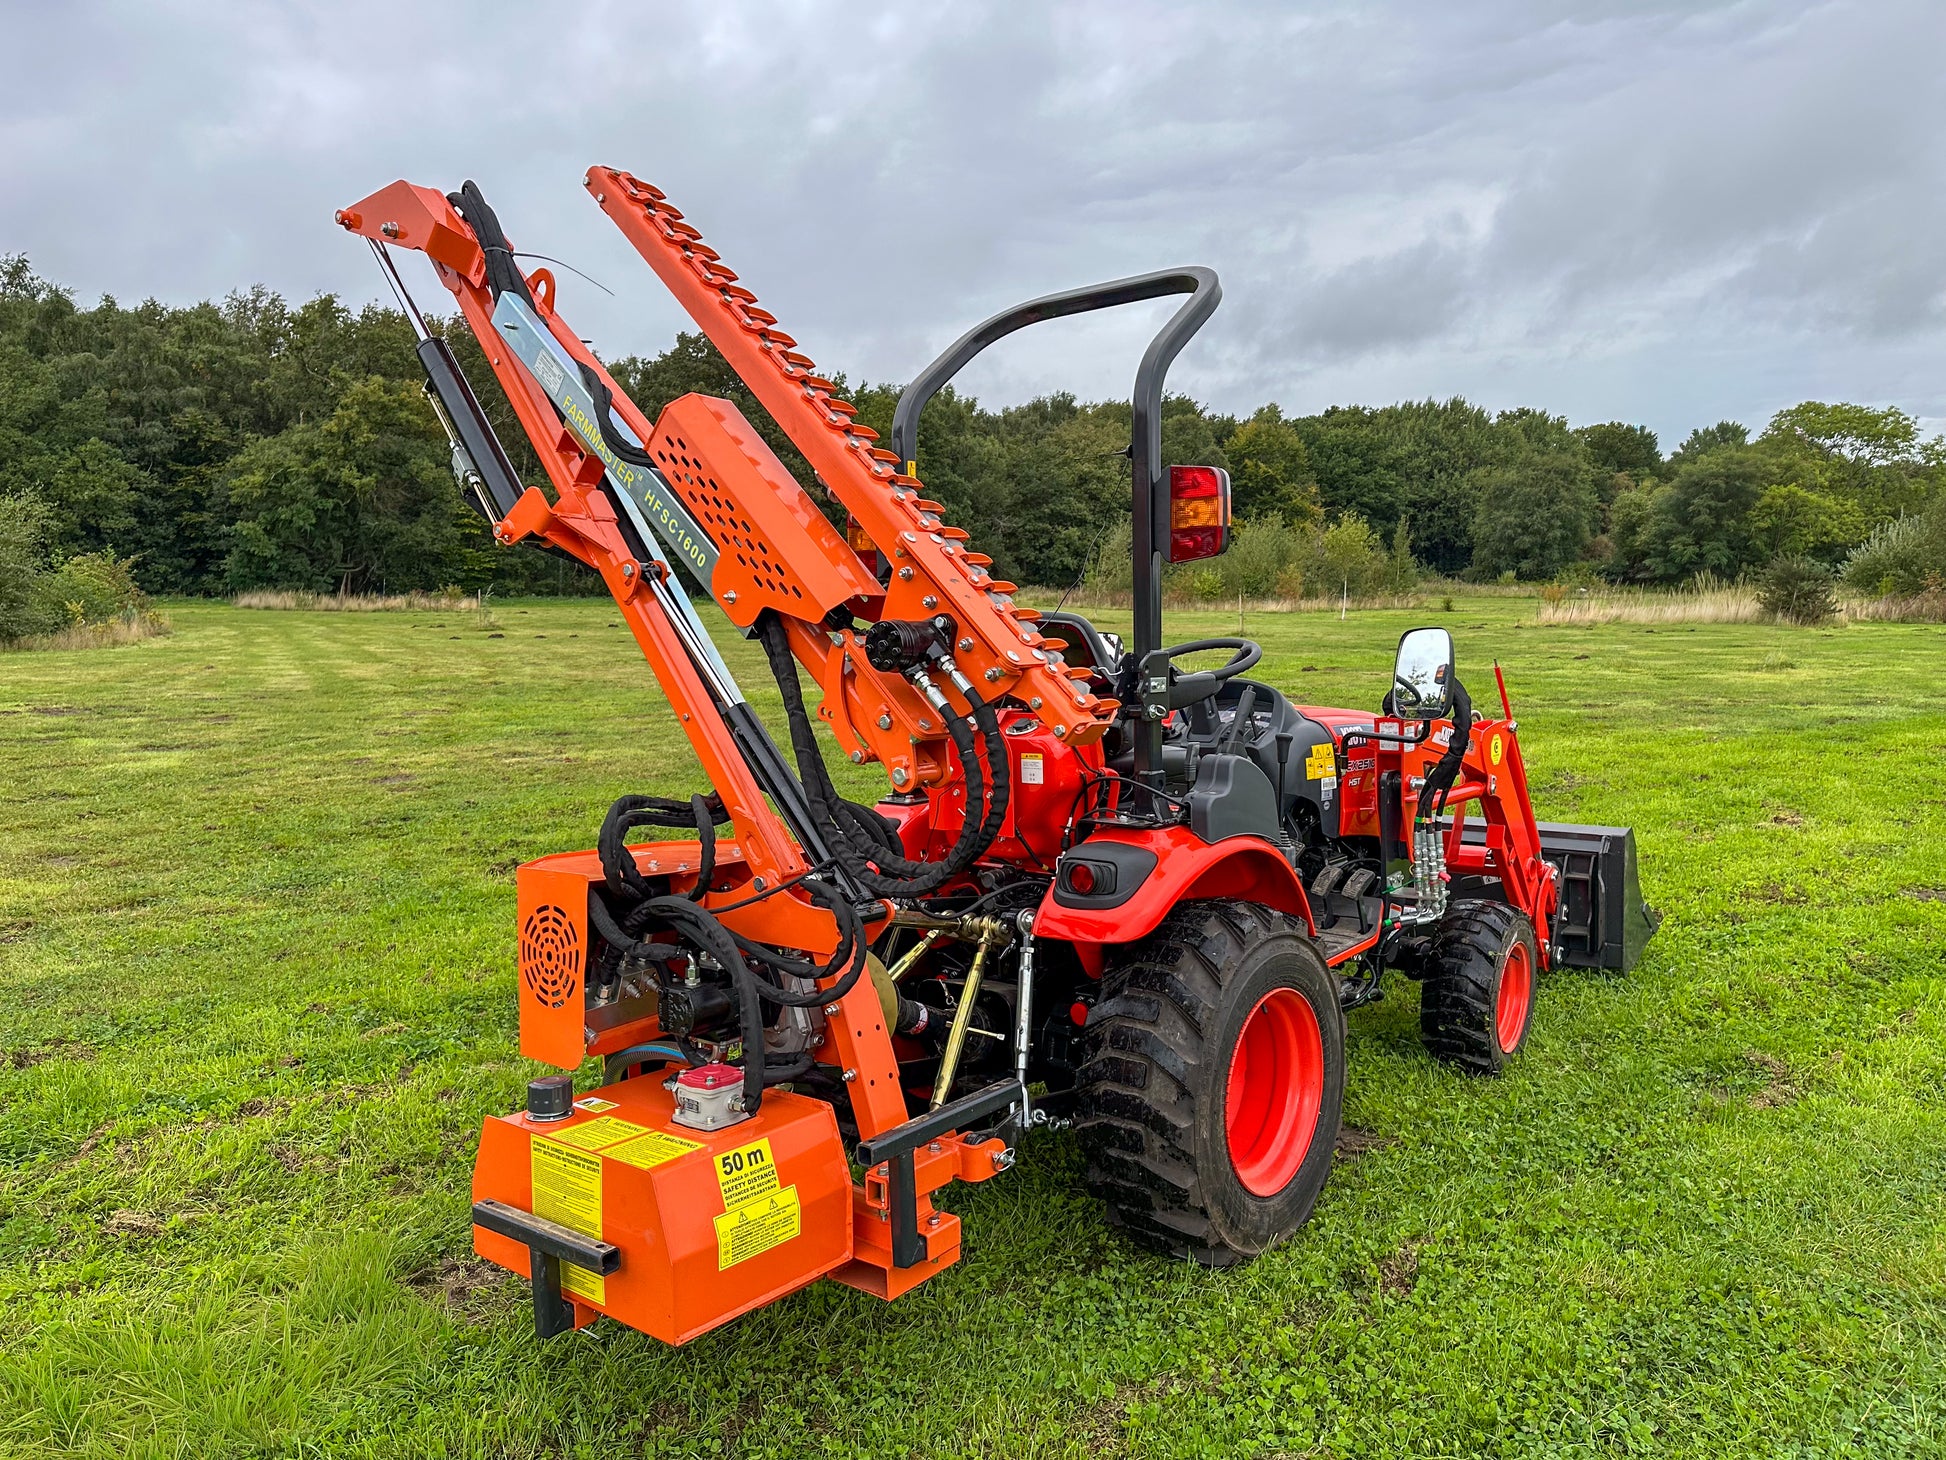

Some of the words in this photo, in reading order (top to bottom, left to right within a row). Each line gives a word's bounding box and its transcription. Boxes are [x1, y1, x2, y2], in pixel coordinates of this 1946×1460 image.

[563, 395, 636, 489] FARMMASTER
[644, 489, 707, 567] HFSC1600
[1348, 777, 1361, 787] HST
[721, 1152, 744, 1176] 50
[746, 1148, 765, 1167] m
[721, 1175, 744, 1187] DISTANZA
[749, 1163, 774, 1176] SICUREZZA
[723, 1181, 746, 1195] SAFETY
[747, 1169, 776, 1185] DISTANCE
[725, 1188, 750, 1201] DISTANCES
